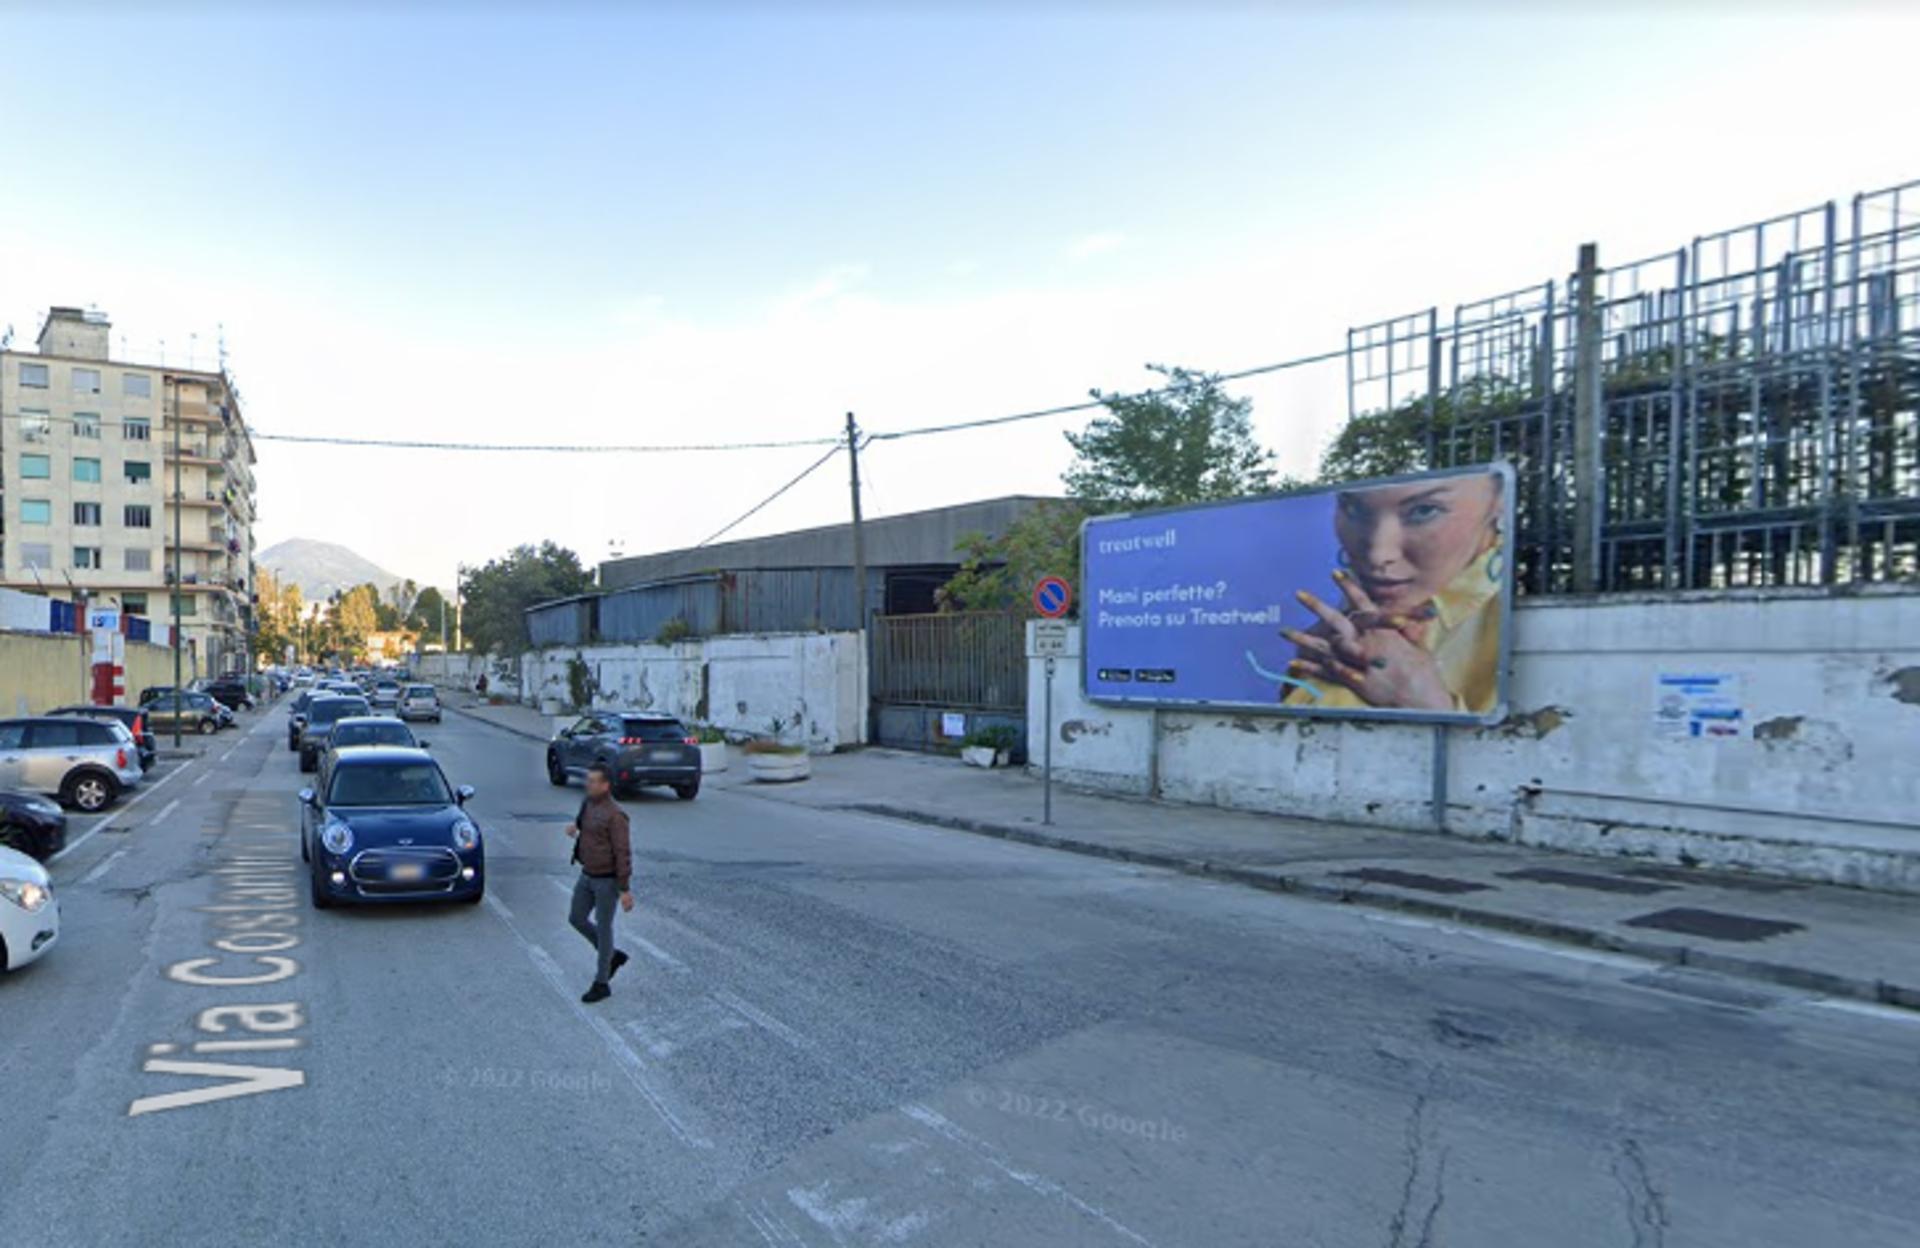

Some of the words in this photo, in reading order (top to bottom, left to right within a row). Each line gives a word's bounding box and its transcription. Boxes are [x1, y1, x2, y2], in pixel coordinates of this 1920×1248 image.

[1099, 528, 1176, 554] treatwell
[1099, 587, 1139, 605] Mani
[1141, 580, 1227, 607] perfette?
[1099, 610, 1162, 628] Prenota
[1165, 613, 1186, 626] su
[1189, 604, 1282, 625] Treatwell
